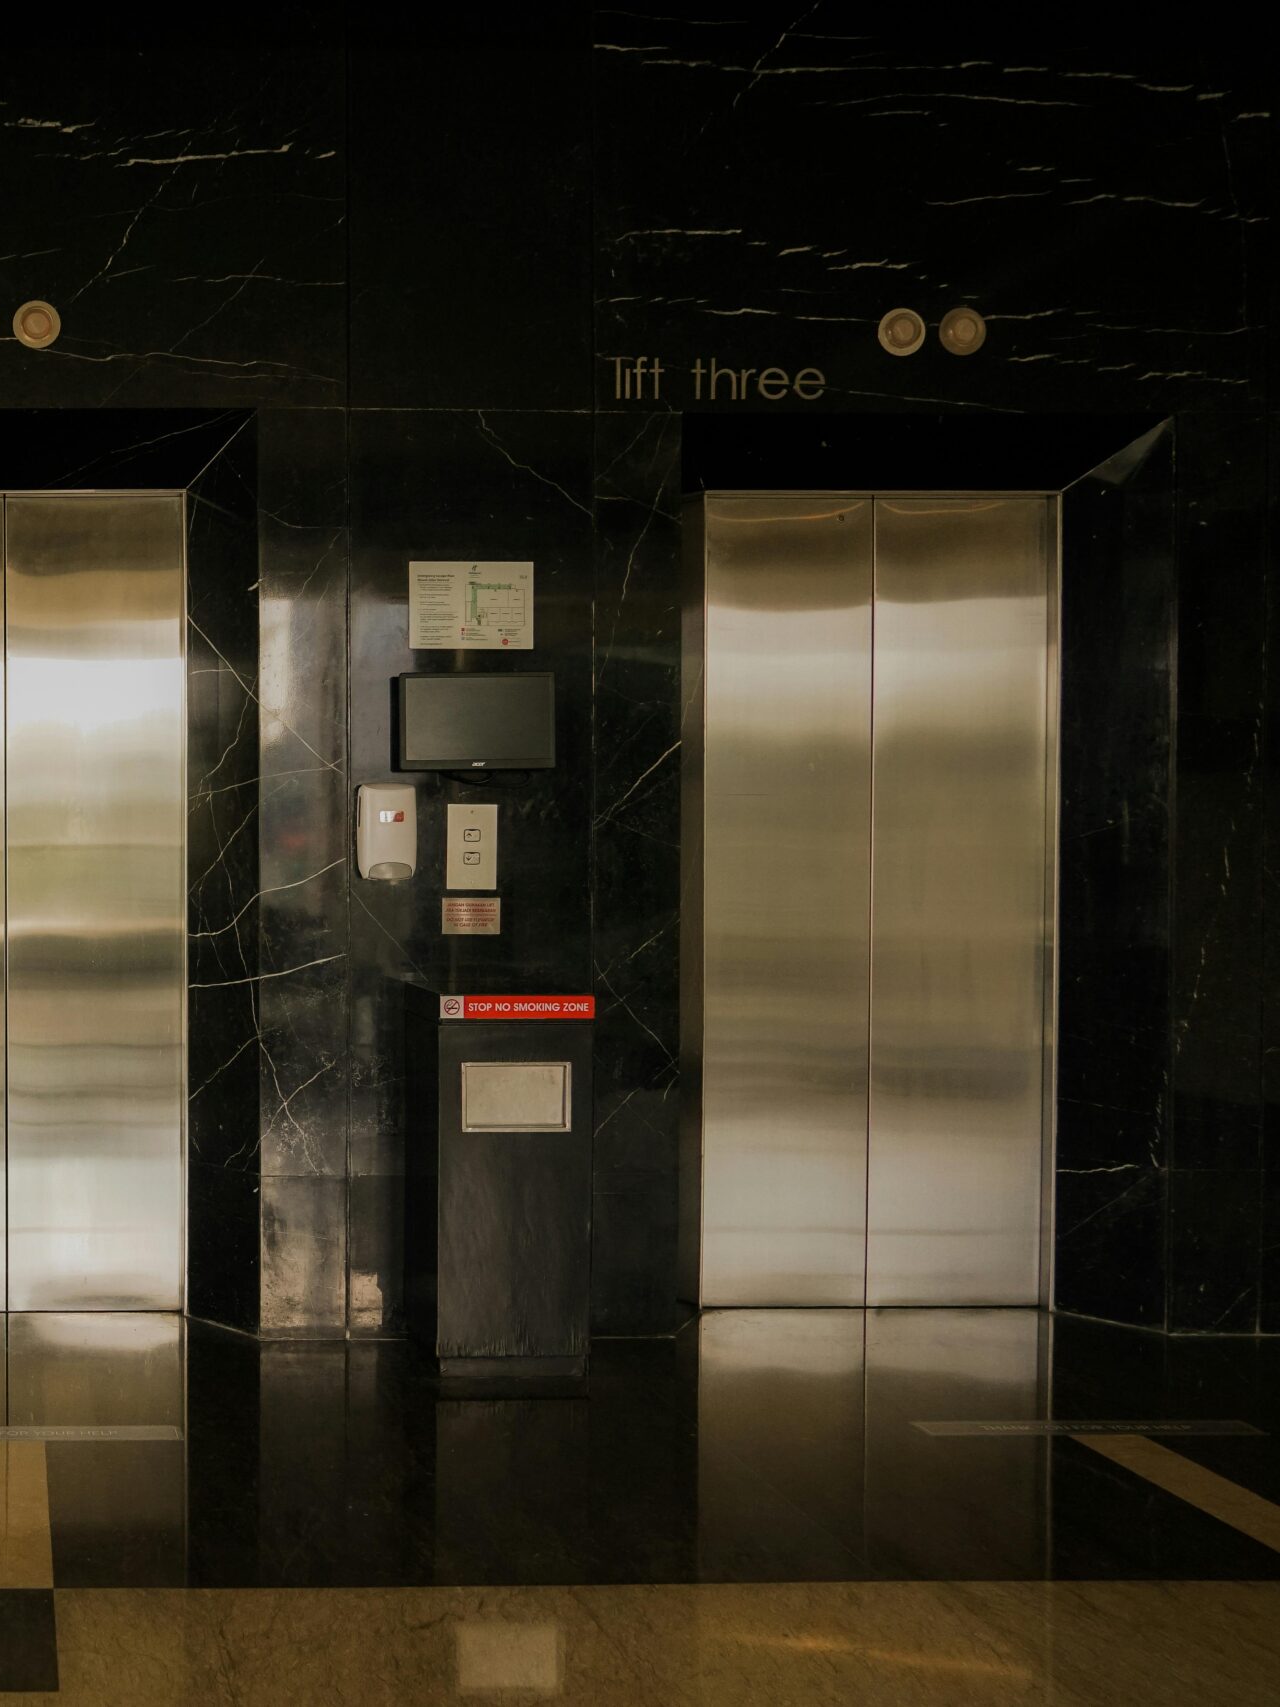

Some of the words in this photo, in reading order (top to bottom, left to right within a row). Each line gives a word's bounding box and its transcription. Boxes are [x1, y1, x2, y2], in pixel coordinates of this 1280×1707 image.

[615, 356, 665, 400] lift
[691, 357, 826, 400] three
[468, 1002, 493, 1012] STOP
[495, 1002, 511, 1012] NO
[513, 1002, 561, 1012] SMOKING
[562, 1002, 589, 1012] ZONE
